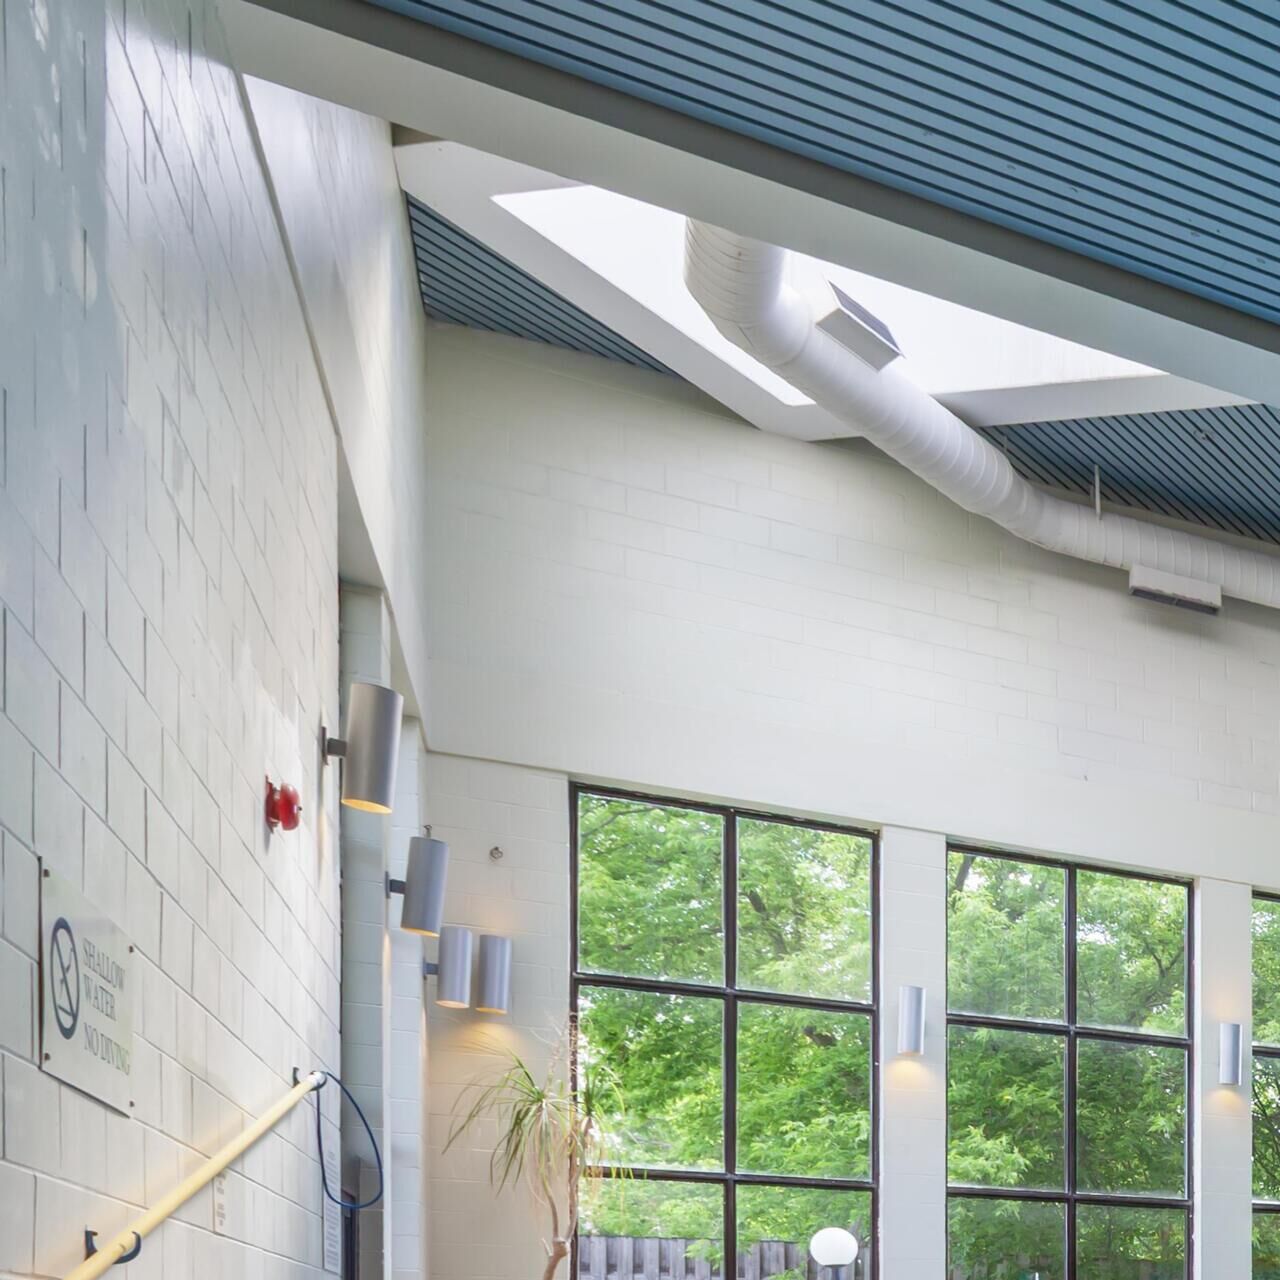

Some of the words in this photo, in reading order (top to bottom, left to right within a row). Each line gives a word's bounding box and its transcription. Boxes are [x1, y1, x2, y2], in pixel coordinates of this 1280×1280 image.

[83, 937, 126, 991] SHALLOW
[83, 973, 117, 1021] WATER
[84, 1021, 99, 1057] NO
[100, 1033, 130, 1076] DIVING
